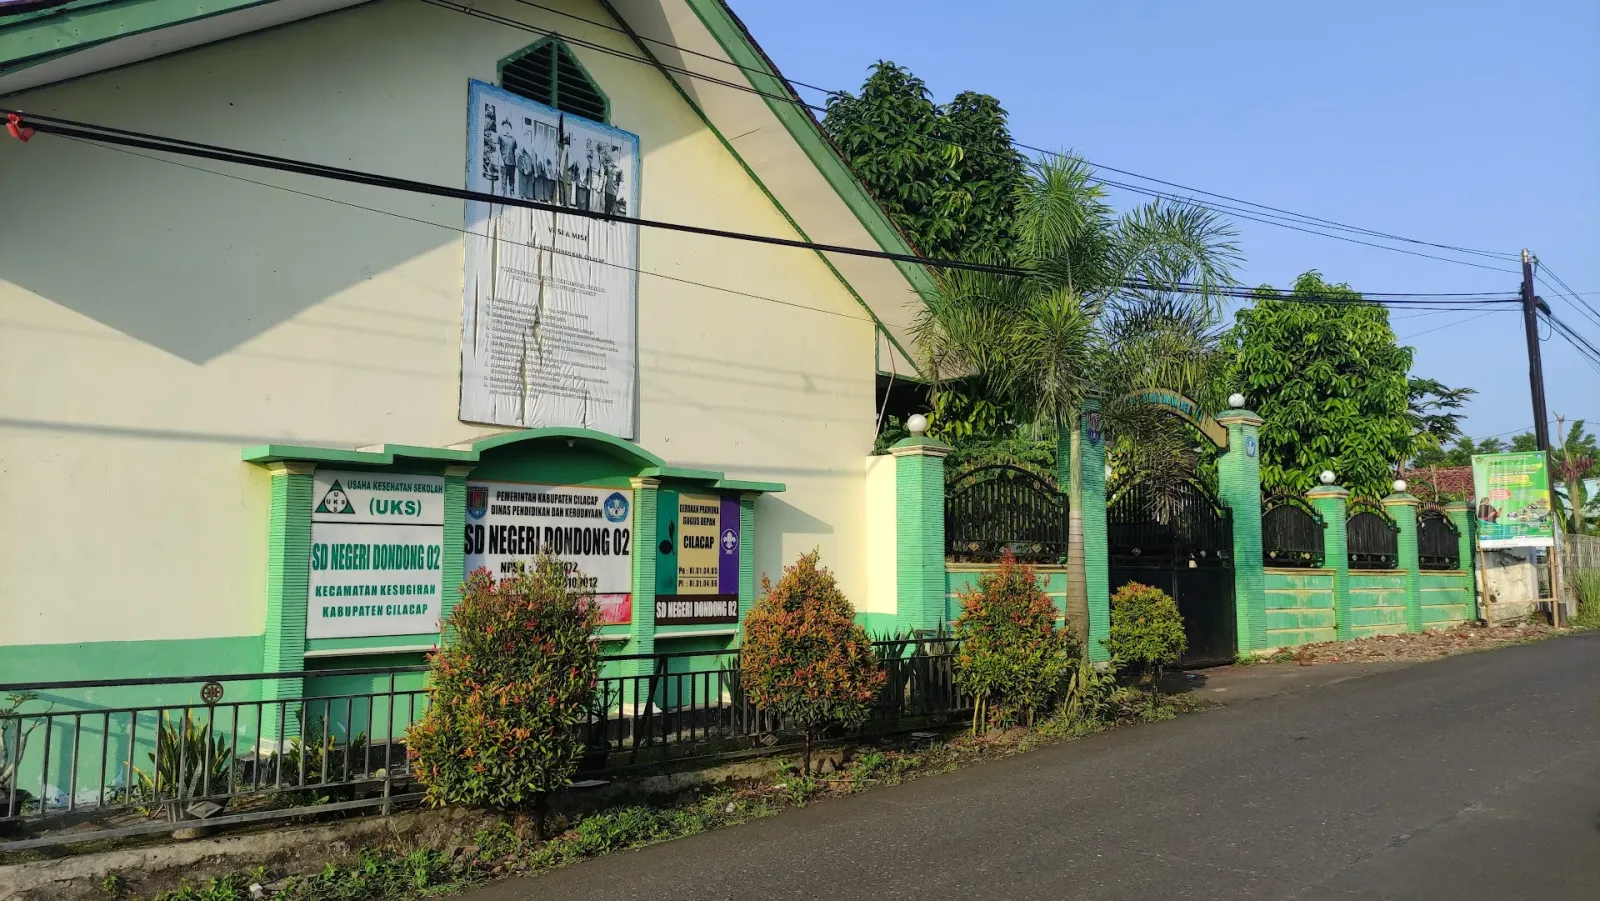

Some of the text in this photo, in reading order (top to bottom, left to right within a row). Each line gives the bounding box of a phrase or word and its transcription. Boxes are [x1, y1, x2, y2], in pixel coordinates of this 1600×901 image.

[572, 232, 587, 242] MISI
[347, 480, 443, 494] USAHA KESEHATAN SEKOLAH
[496, 491, 599, 506] PEMERINTAH KABUPATEN CILACAP
[369, 497, 422, 517] (UKS)
[491, 504, 603, 519] DINAS PENDIDIKAN DAN KEBUDAYAAN
[683, 516, 715, 526] GUGUS DEPAN
[464, 524, 630, 556] SD NEGERI DONDONG 02
[683, 535, 714, 549] CILACAP
[312, 543, 440, 571] SD NEGERI DONDONG 02
[315, 584, 436, 597] KECAMATAN KESUGIHAN
[322, 604, 428, 618] KABUPATEN CILACAP
[656, 600, 737, 618] SD NEGERI DONDONG 02
